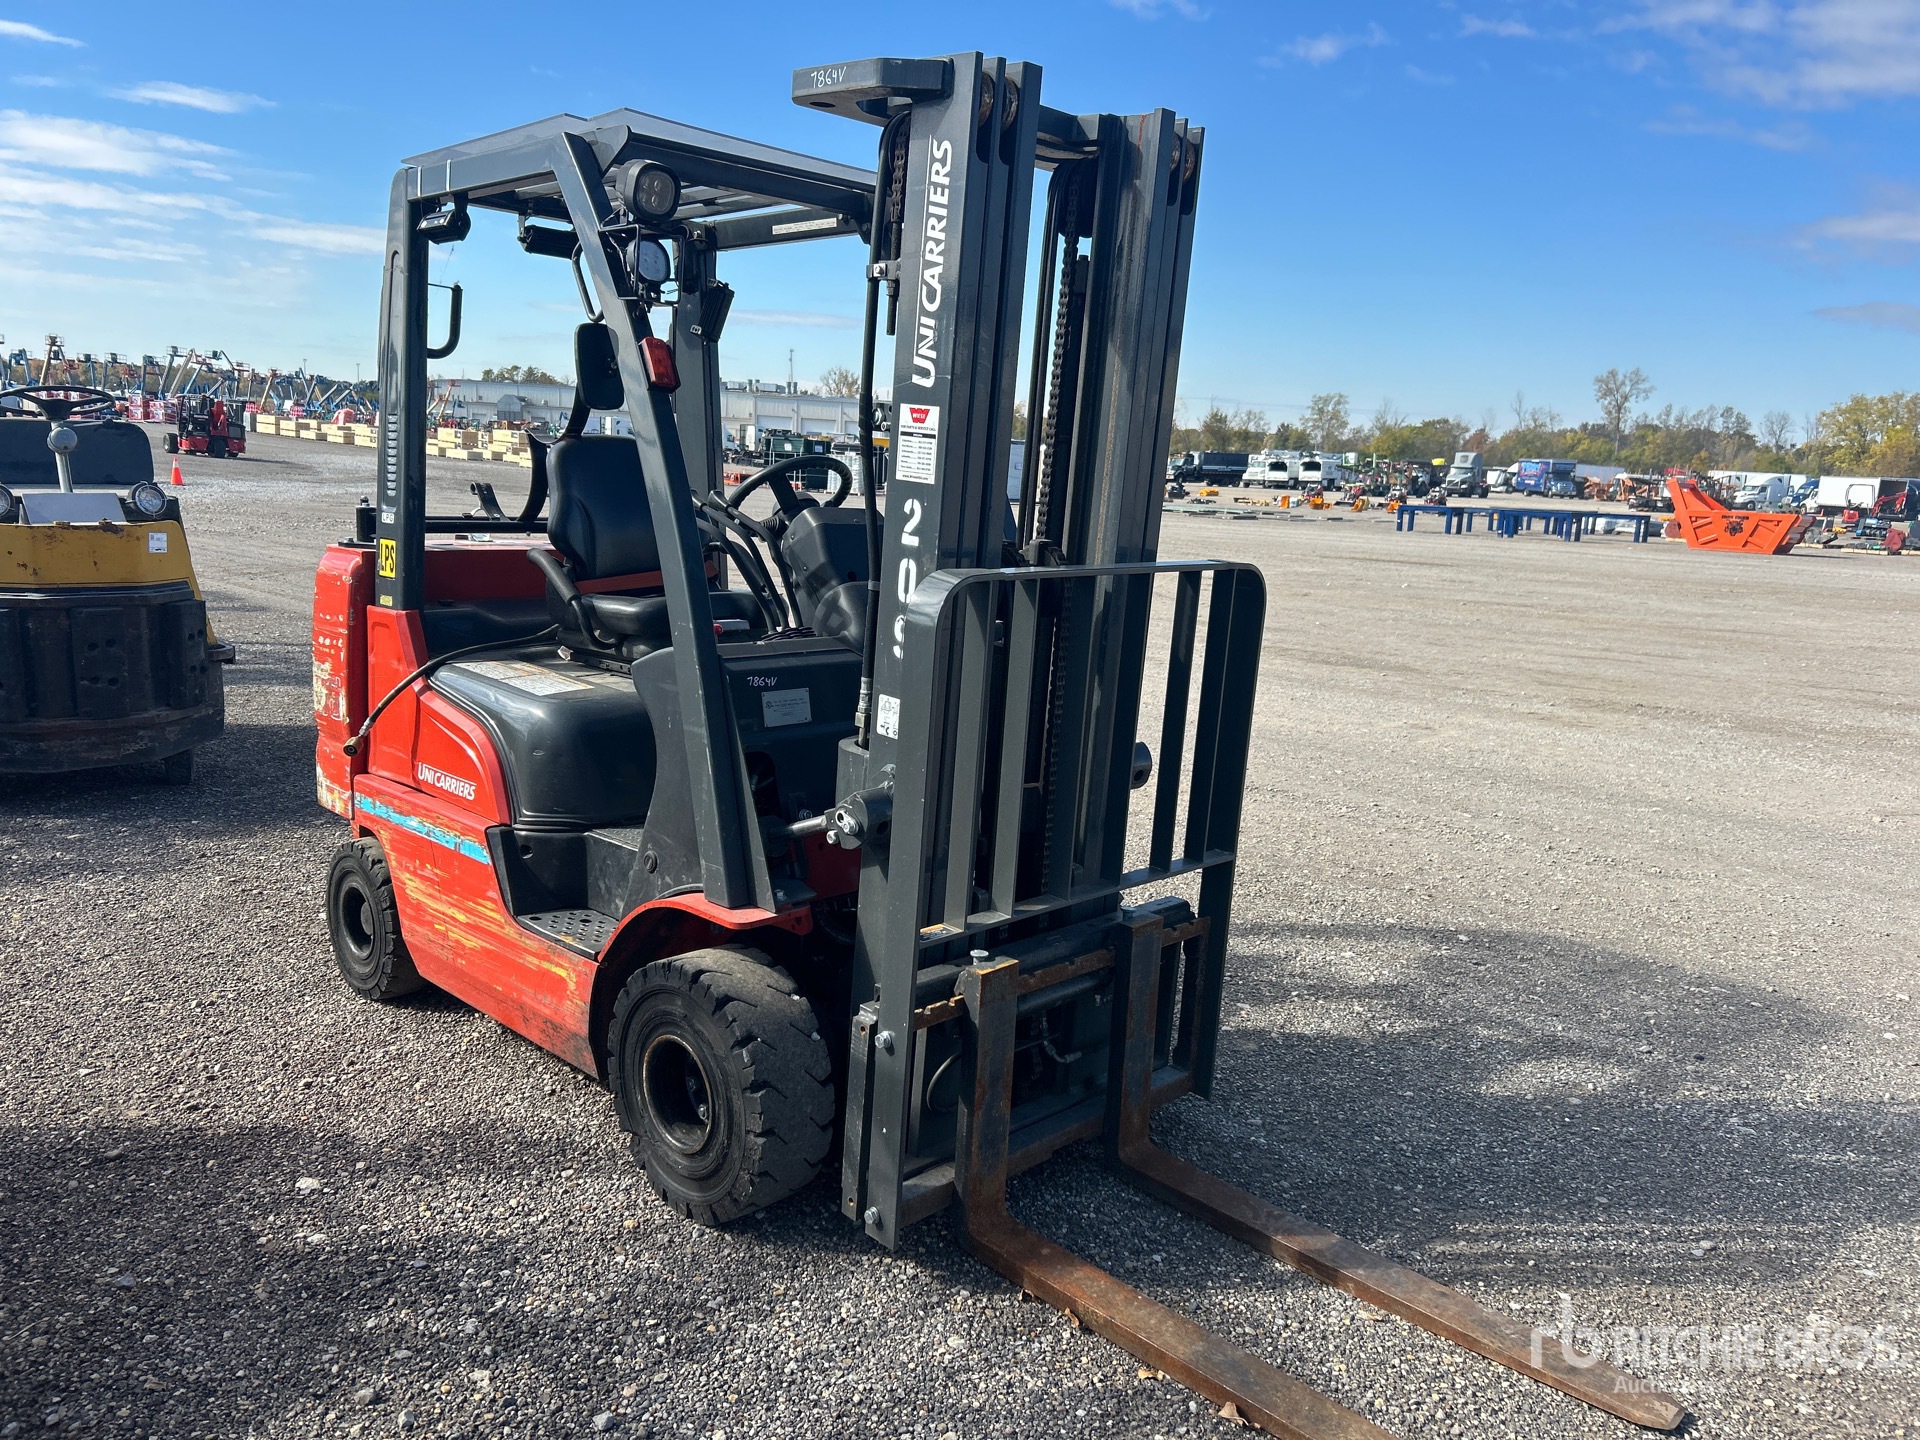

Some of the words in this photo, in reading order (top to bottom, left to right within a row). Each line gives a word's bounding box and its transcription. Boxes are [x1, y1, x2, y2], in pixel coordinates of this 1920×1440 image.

[911, 135, 953, 388] UNICARRIERS
[382, 513, 394, 523] LPG
[380, 543, 395, 574] LPS
[417, 762, 477, 800] UNICARRIERS
